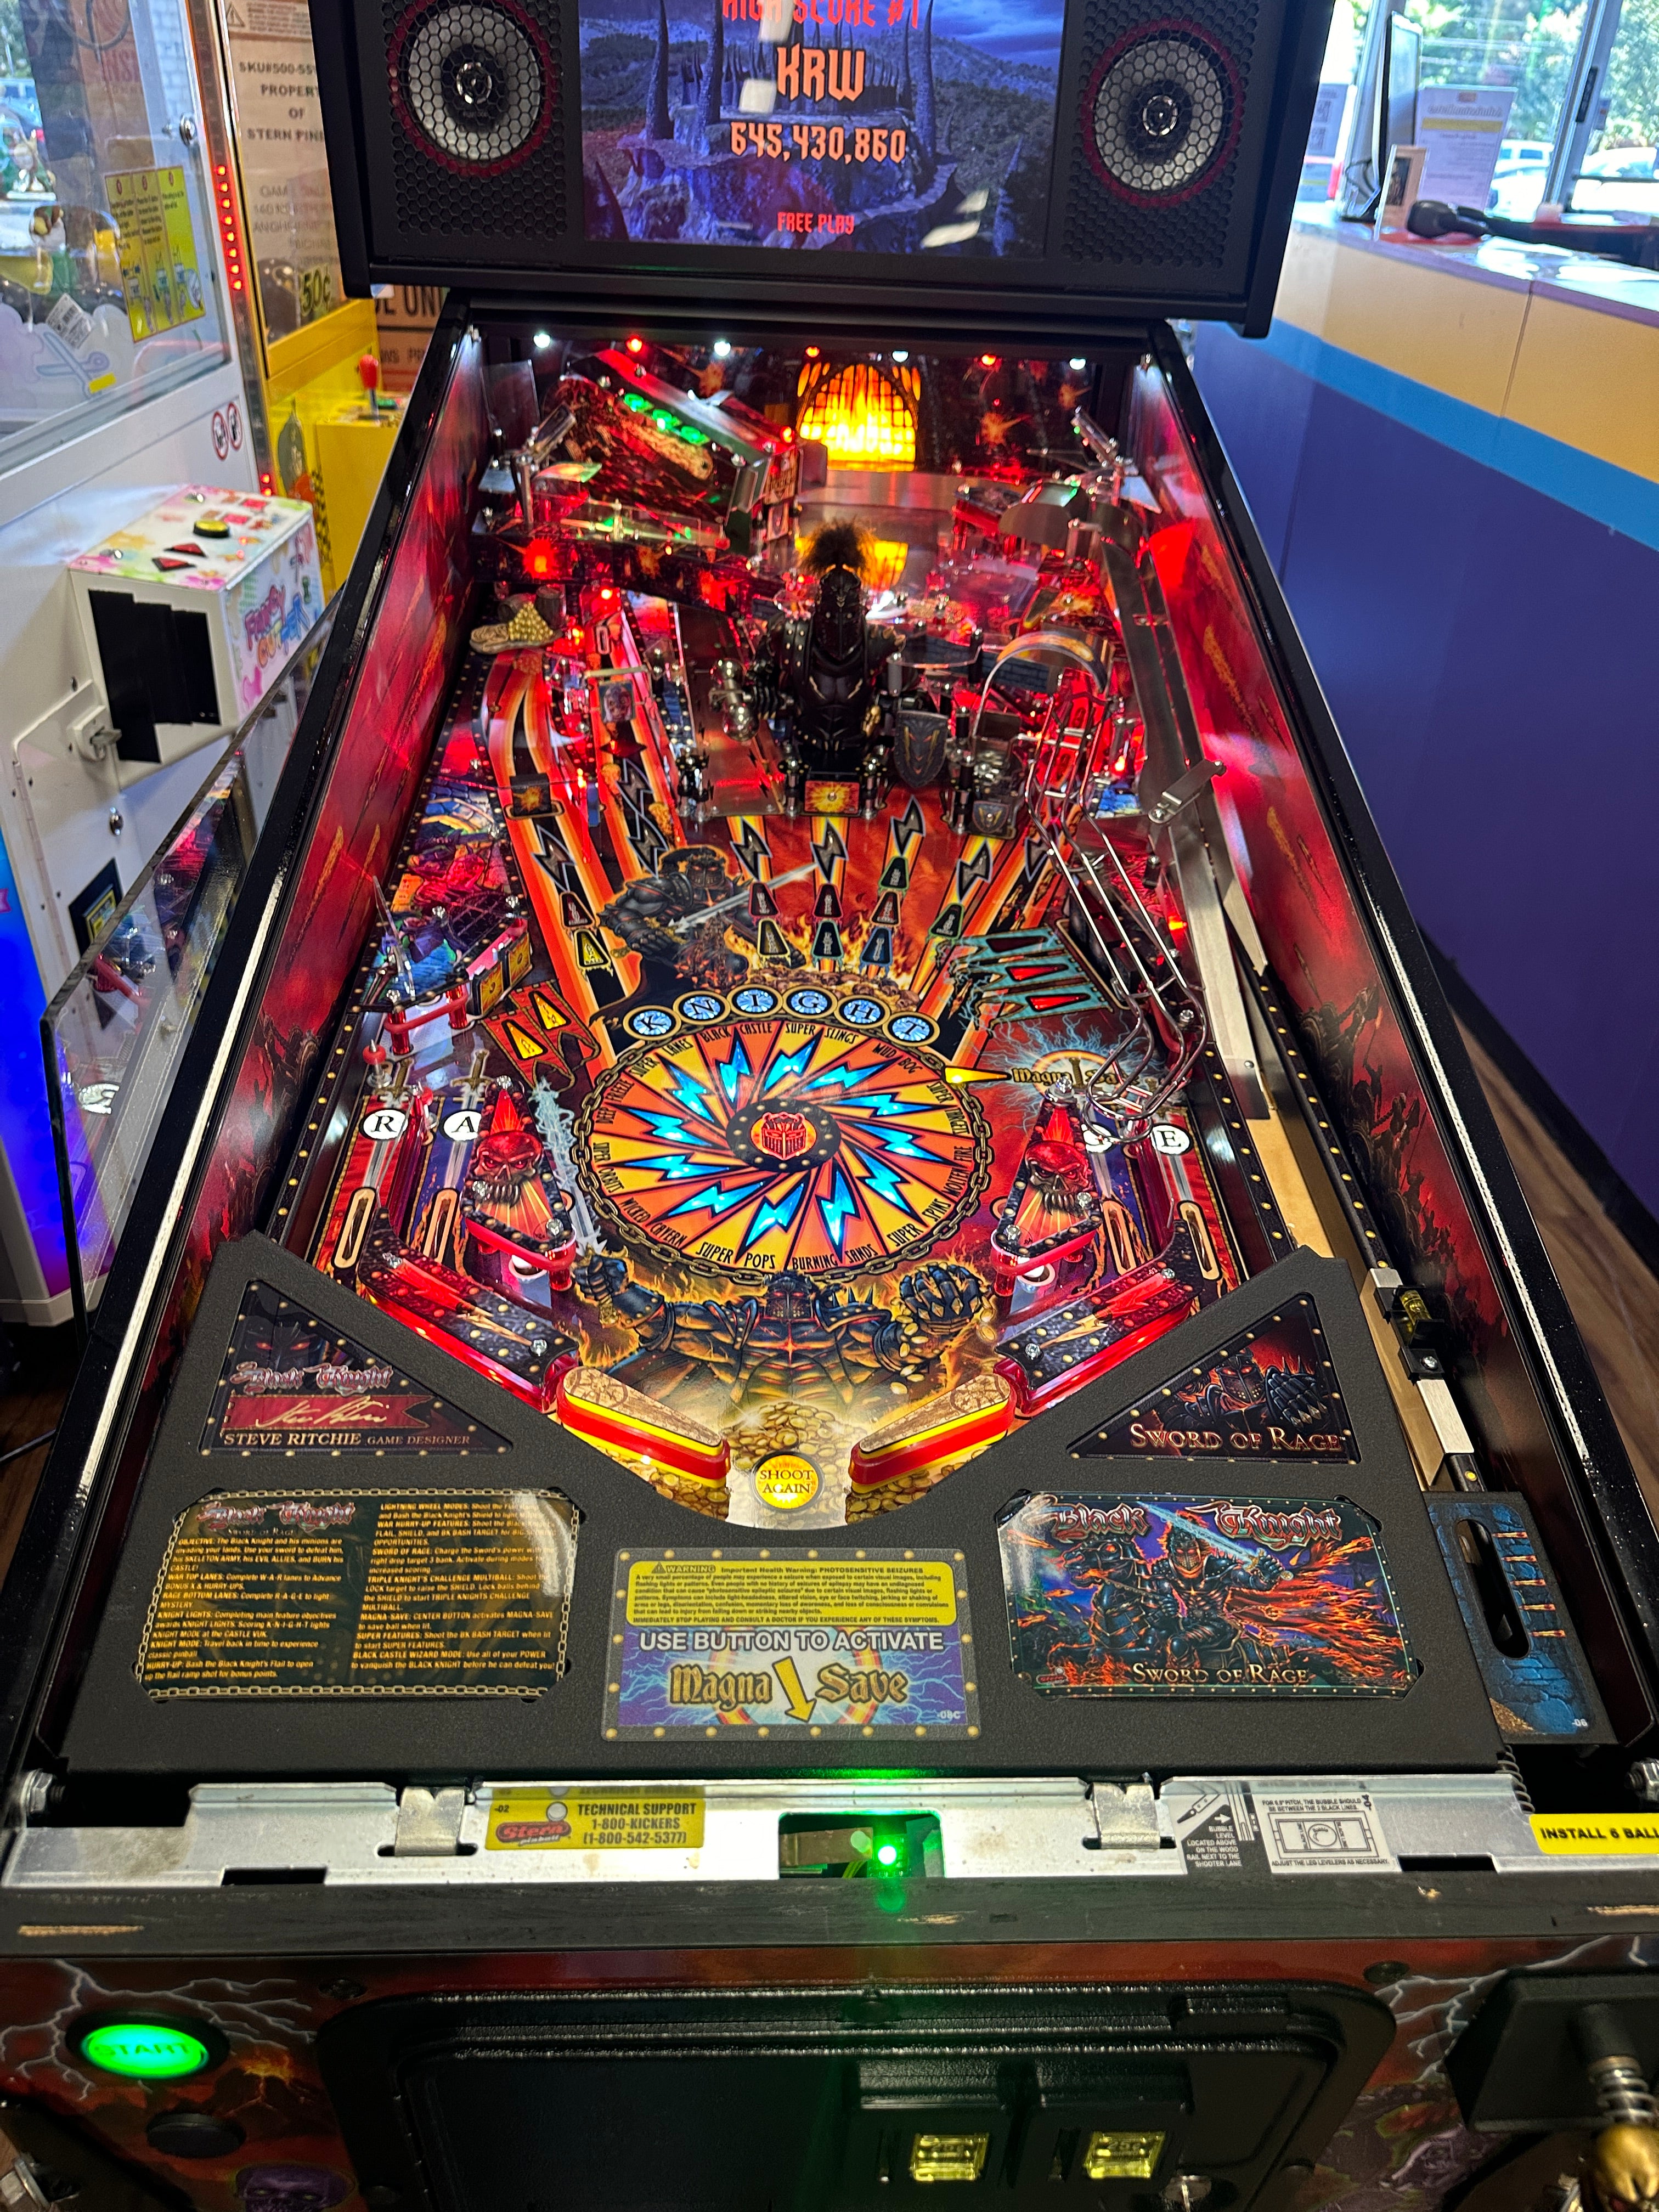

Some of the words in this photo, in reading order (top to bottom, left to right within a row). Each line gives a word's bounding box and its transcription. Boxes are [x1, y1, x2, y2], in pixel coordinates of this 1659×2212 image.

[777, 43, 865, 102] KRW
[289, 108, 306, 119] OF
[247, 128, 292, 141] STERN
[730, 121, 907, 165] 645,430,860
[777, 211, 813, 233] FREE
[817, 213, 855, 235] PLAY
[701, 1026, 731, 1042] BLACK
[740, 1022, 772, 1035] CASTLE
[786, 1023, 816, 1035] SUPER
[824, 1028, 859, 1044] SLINGS
[629, 1055, 660, 1077] SUPER
[662, 1038, 694, 1057] LANES
[872, 1043, 898, 1058] MUD
[898, 1056, 923, 1074] BOG
[605, 1078, 635, 1103] FREEZE
[927, 1081, 954, 1104] SUPER
[371, 1117, 394, 1132] R
[453, 1117, 477, 1133] A
[1157, 1130, 1182, 1147] E
[953, 1146, 973, 1163] FIRE
[941, 1167, 969, 1198] MOLTEN
[620, 1197, 651, 1223] WICKED
[650, 1223, 688, 1248] CAVERN
[887, 1223, 924, 1247] SUPER
[922, 1198, 952, 1222] SPINS
[696, 1242, 734, 1264] SUPER
[744, 1252, 776, 1269] POPS
[792, 1254, 838, 1270] BURNING
[844, 1244, 878, 1263] SANDS
[224, 1432, 283, 1446] STEVE
[287, 1432, 362, 1446] RITCHIE
[367, 1435, 404, 1446] GAME
[407, 1435, 470, 1446] DESIGNER
[1130, 1423, 1222, 1448] SWORD
[1229, 1432, 1262, 1449] OF
[760, 1469, 814, 1482] SHOOT
[762, 1483, 812, 1496] AGAIN
[665, 1565, 715, 1573] WARNING
[640, 1630, 687, 1651] USE
[693, 1630, 792, 1651] BUTTON
[794, 1630, 829, 1651] TO
[836, 1630, 945, 1650] ACTIVATE
[1132, 1662, 1209, 1684] SWORD
[1217, 1668, 1242, 1684] OF
[1249, 1663, 1309, 1684] RAGE
[669, 1664, 773, 1711] Magna
[814, 1663, 909, 1704] Save
[1571, 1718, 1588, 1728] -06
[494, 1804, 509, 1813] -02
[578, 1803, 640, 1815] TECHNICAL
[643, 1802, 697, 1815] SUPPORT
[502, 1823, 565, 1839] Stern
[592, 1818, 680, 1830] 1-800-KICKERS
[1540, 1827, 1607, 1839] INSTALL
[1609, 1827, 1620, 1839] 6
[583, 1831, 687, 1844] (1-800-542-5377)
[93, 2041, 192, 2057] START
